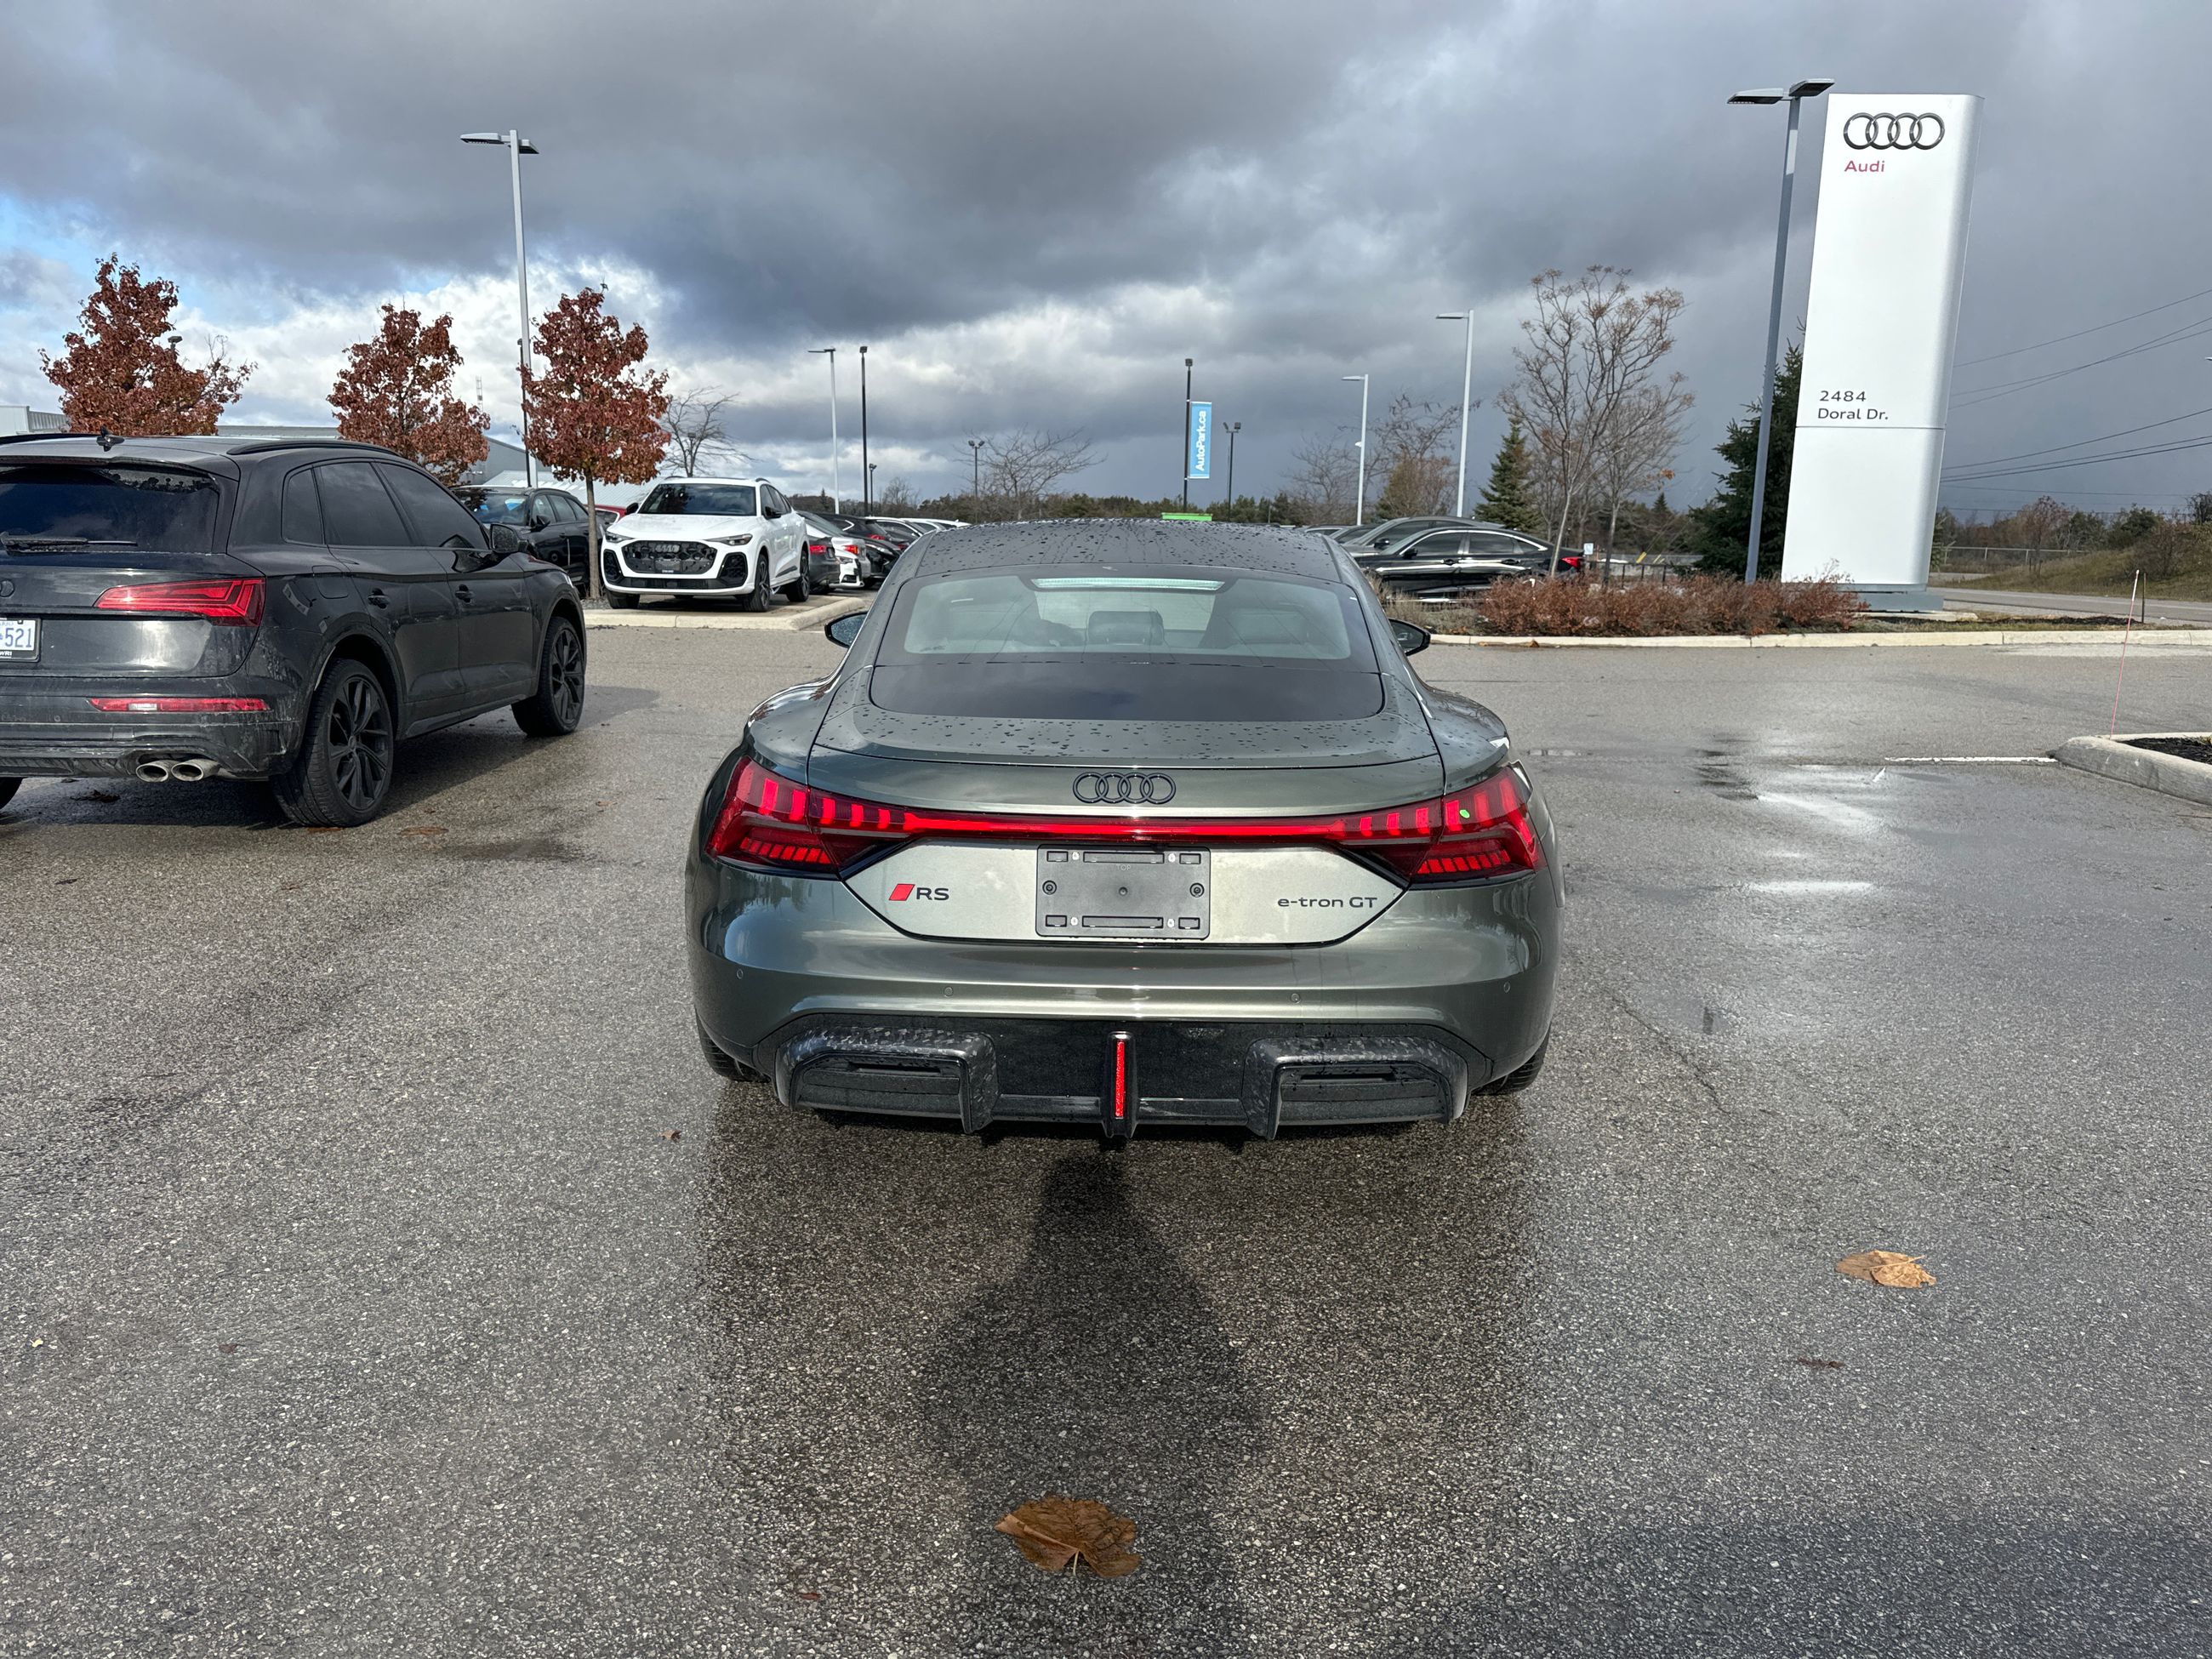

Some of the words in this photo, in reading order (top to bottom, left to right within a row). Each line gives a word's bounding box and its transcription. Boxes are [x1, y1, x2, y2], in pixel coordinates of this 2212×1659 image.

[1844, 160, 1885, 173] Audi
[1819, 390, 1867, 402] 2484
[1817, 408, 1861, 419] Doral
[1867, 408, 1889, 420] Dr.
[1194, 410, 1207, 471] AutoPark.ca
[916, 887, 949, 901] RS
[1277, 897, 1344, 908] e-tron
[1348, 896, 1378, 909] GT
